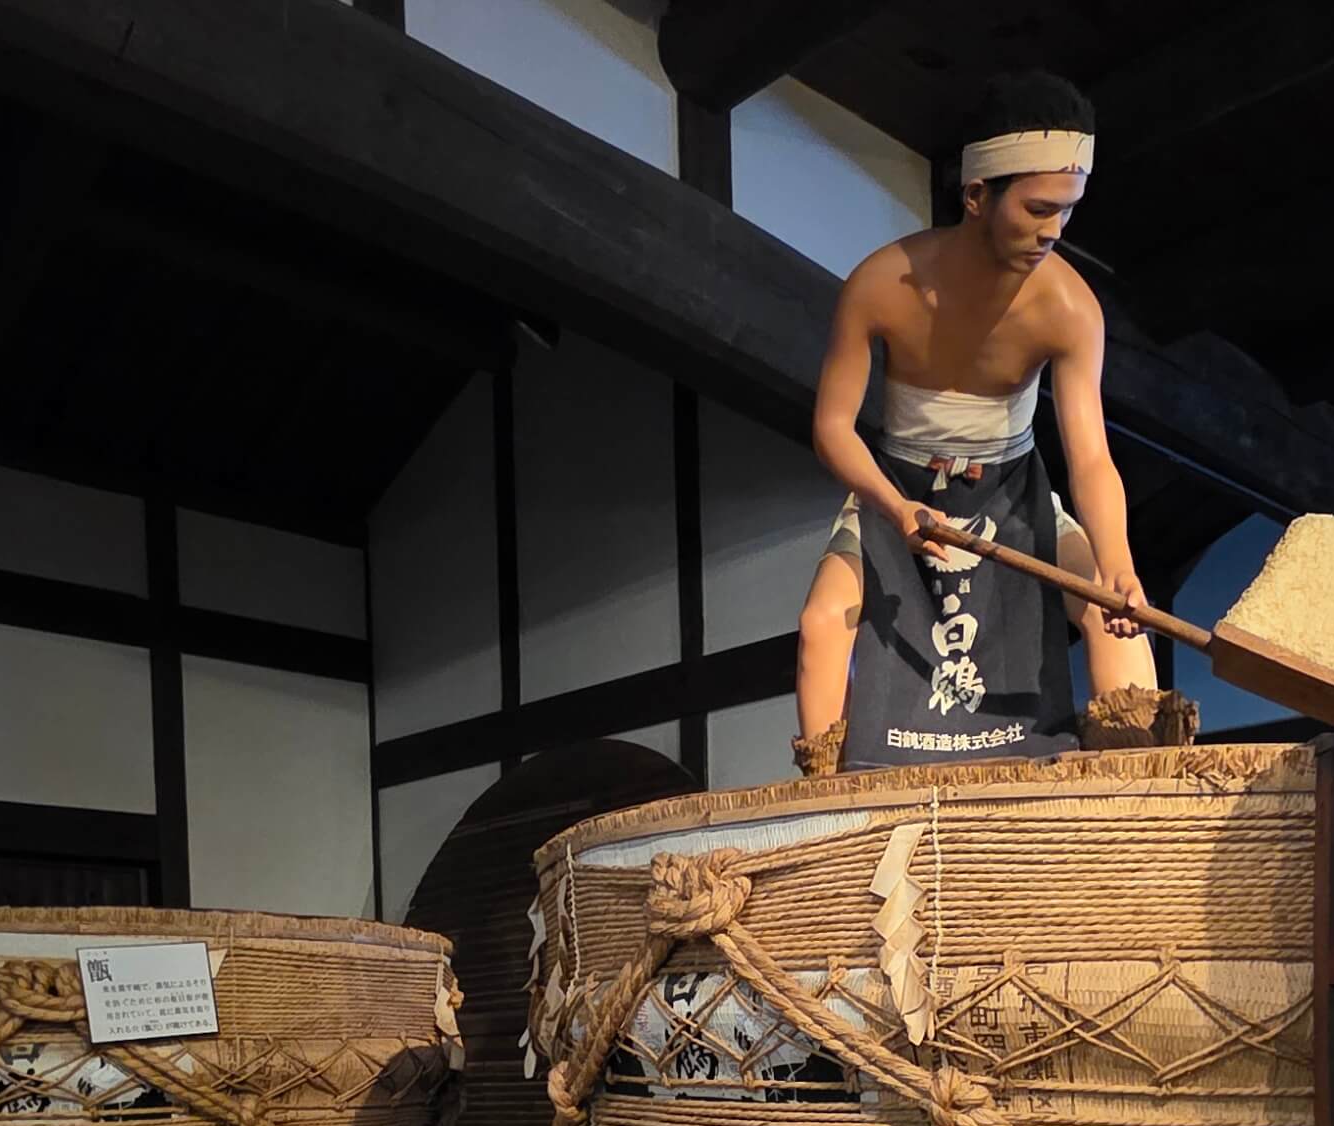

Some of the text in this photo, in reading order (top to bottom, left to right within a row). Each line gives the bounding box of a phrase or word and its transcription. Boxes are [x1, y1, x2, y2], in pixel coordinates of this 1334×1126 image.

[928, 593, 987, 717] 白鶴
[886, 722, 1026, 753] 白鶴酒造株式会社
